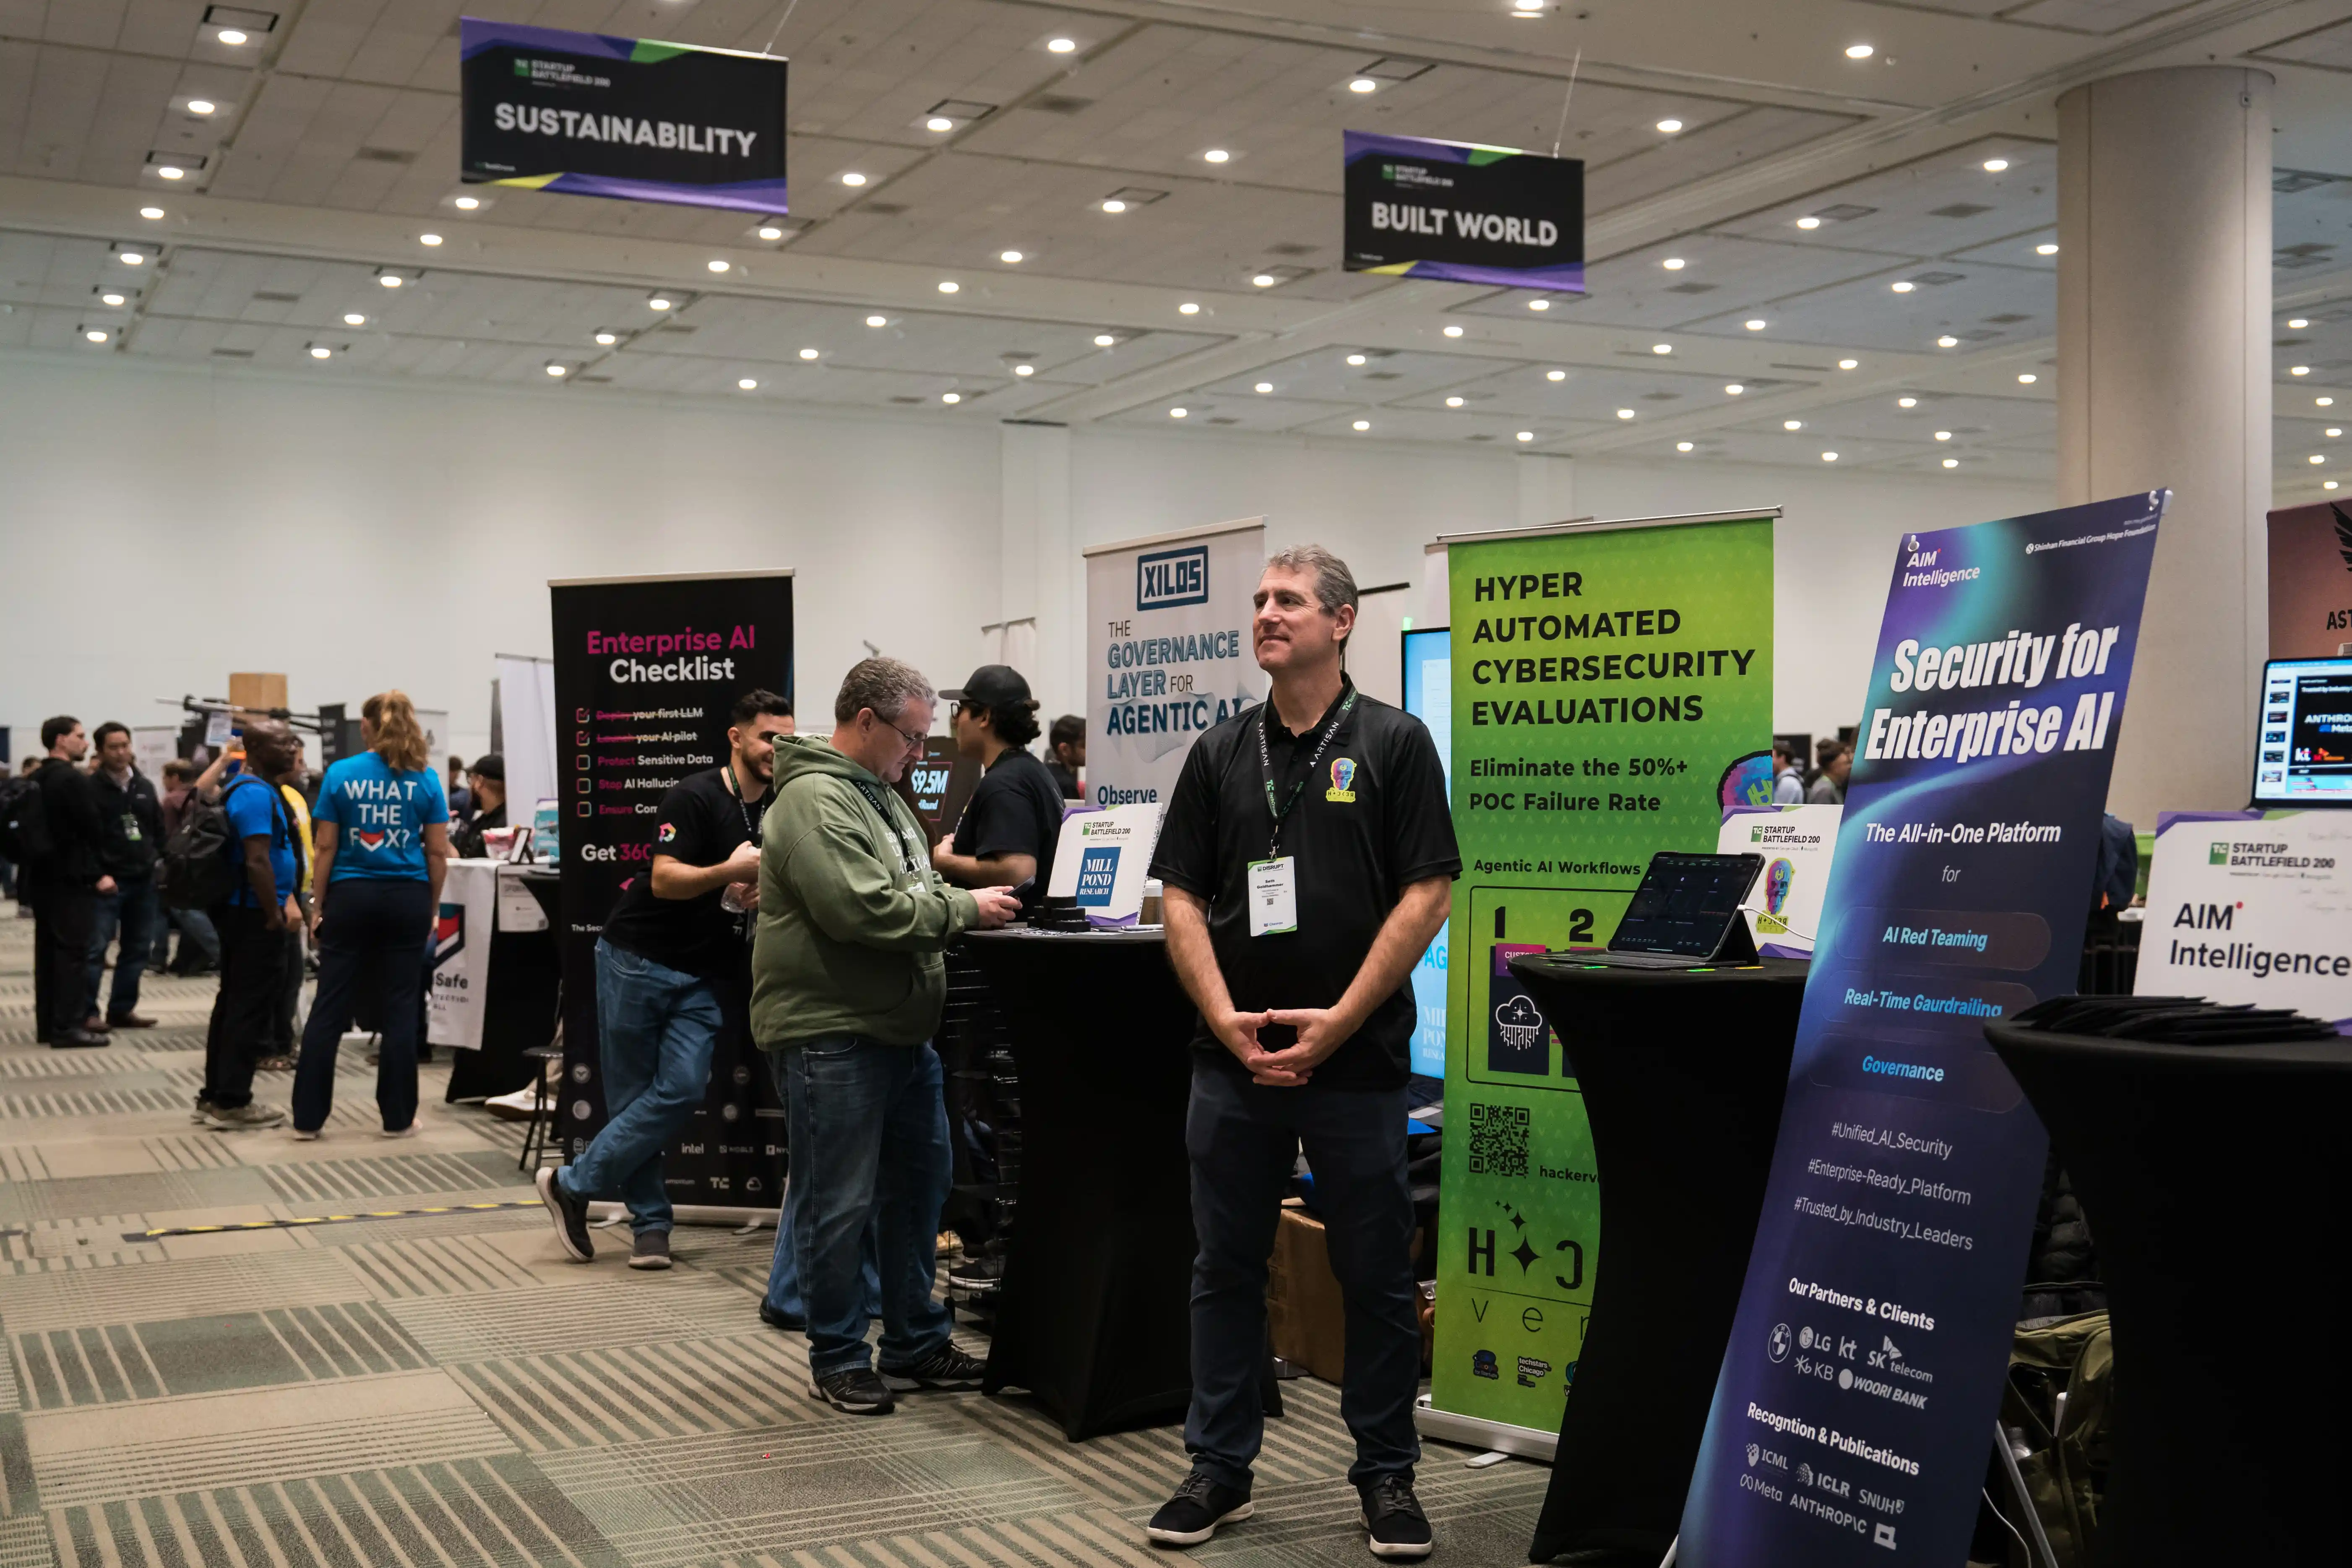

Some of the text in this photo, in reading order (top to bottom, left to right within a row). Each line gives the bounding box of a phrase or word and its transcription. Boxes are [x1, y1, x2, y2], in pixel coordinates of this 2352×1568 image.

[531, 60, 575, 72] STARTUP
[531, 70, 593, 84] BATTLEFIELD
[495, 103, 756, 157] SUSTAINABILITY
[1372, 202, 1558, 247] BUILT WORLD
[2034, 542, 2058, 551] Shinhan
[2058, 536, 2086, 547] Financial
[2107, 532, 2123, 540] Hope
[2124, 524, 2156, 537] Foundation
[1907, 551, 1937, 568] AIM
[1144, 559, 1201, 598] XILOS
[1475, 571, 1583, 602] HYPER
[1903, 565, 1980, 587] Intelligence
[1108, 620, 1131, 638] THE
[1472, 609, 1681, 643] AUTOMATED
[587, 625, 755, 657] Enterprise AI
[1108, 630, 1239, 669] GOVERNANCE
[609, 656, 735, 683] Checklist
[1473, 649, 1756, 685] CYBERSECURITY
[1890, 623, 2120, 693] Security for
[1107, 669, 1193, 699] LAYER FOR
[633, 711, 656, 721] your
[658, 708, 678, 719] first
[680, 708, 703, 718] LLM
[1107, 700, 1209, 735] AGENTIC
[1472, 695, 1703, 726] EVALUATIONS
[636, 734, 659, 744] your
[661, 732, 672, 741] AI
[674, 731, 698, 742] pilot
[1864, 692, 2115, 763] Enterprise AI
[1258, 729, 1269, 766] ARTISAN
[1315, 721, 1339, 760] ARTISAN
[598, 754, 714, 766] Protect Sensitive Data
[1470, 758, 1688, 777] Eliminate the 50%+
[344, 779, 418, 801] WHAT
[599, 779, 623, 790] Stop
[624, 779, 635, 789] AI
[911, 768, 949, 794] $9.5M
[856, 781, 881, 810] ARTISAN
[1098, 785, 1157, 805] Observe
[1470, 792, 1661, 811] POC Failure Rate
[358, 804, 402, 825] THE
[599, 805, 633, 814] Ensure
[1866, 821, 2061, 844] The All-in-One Platform
[581, 844, 616, 861] Get
[2233, 843, 2288, 854] STARTUP
[1084, 858, 1114, 872] MILL
[1474, 859, 1532, 874] Agentic
[1537, 861, 1552, 873] AI
[1558, 861, 1641, 875] Workflows
[1942, 865, 1961, 882] for
[2231, 856, 2336, 869] BATTLEFIELD 200
[1081, 874, 1112, 886] POND
[1495, 906, 1594, 943] 1 2
[2173, 903, 2234, 930] AIM
[1883, 926, 1987, 952] AI Red Teaming
[2170, 939, 2351, 978] Intelligence
[1844, 989, 1911, 1010] Real-Time
[1862, 1055, 1944, 1082] Governance
[681, 1143, 704, 1154] intel
[1831, 1122, 1953, 1160] #Unified_AI_Security
[710, 1177, 730, 1189] TC
[1539, 1165, 1597, 1183] hackerv
[1808, 1158, 1972, 1206] #Enterprise-Ready_Platform
[1794, 1196, 1973, 1250] #Trusted_by_Industry_Leaders
[1789, 1277, 1935, 1331] Our Partners & Clients
[1814, 1333, 1831, 1352] LG
[1838, 1336, 1857, 1360] kt
[1519, 1357, 1548, 1368] techstars
[1519, 1365, 1544, 1376] Chicago
[1814, 1362, 1834, 1381] KB
[1868, 1350, 1933, 1383] SK telecom
[1853, 1375, 1928, 1410] WOORI BANK
[1748, 1401, 1920, 1476] Recogntion & Publications
[1761, 1448, 1788, 1470] ICML
[1754, 1478, 1783, 1503] Meta
[1817, 1473, 1850, 1497] ICLR
[1859, 1488, 1896, 1515] SNUH
